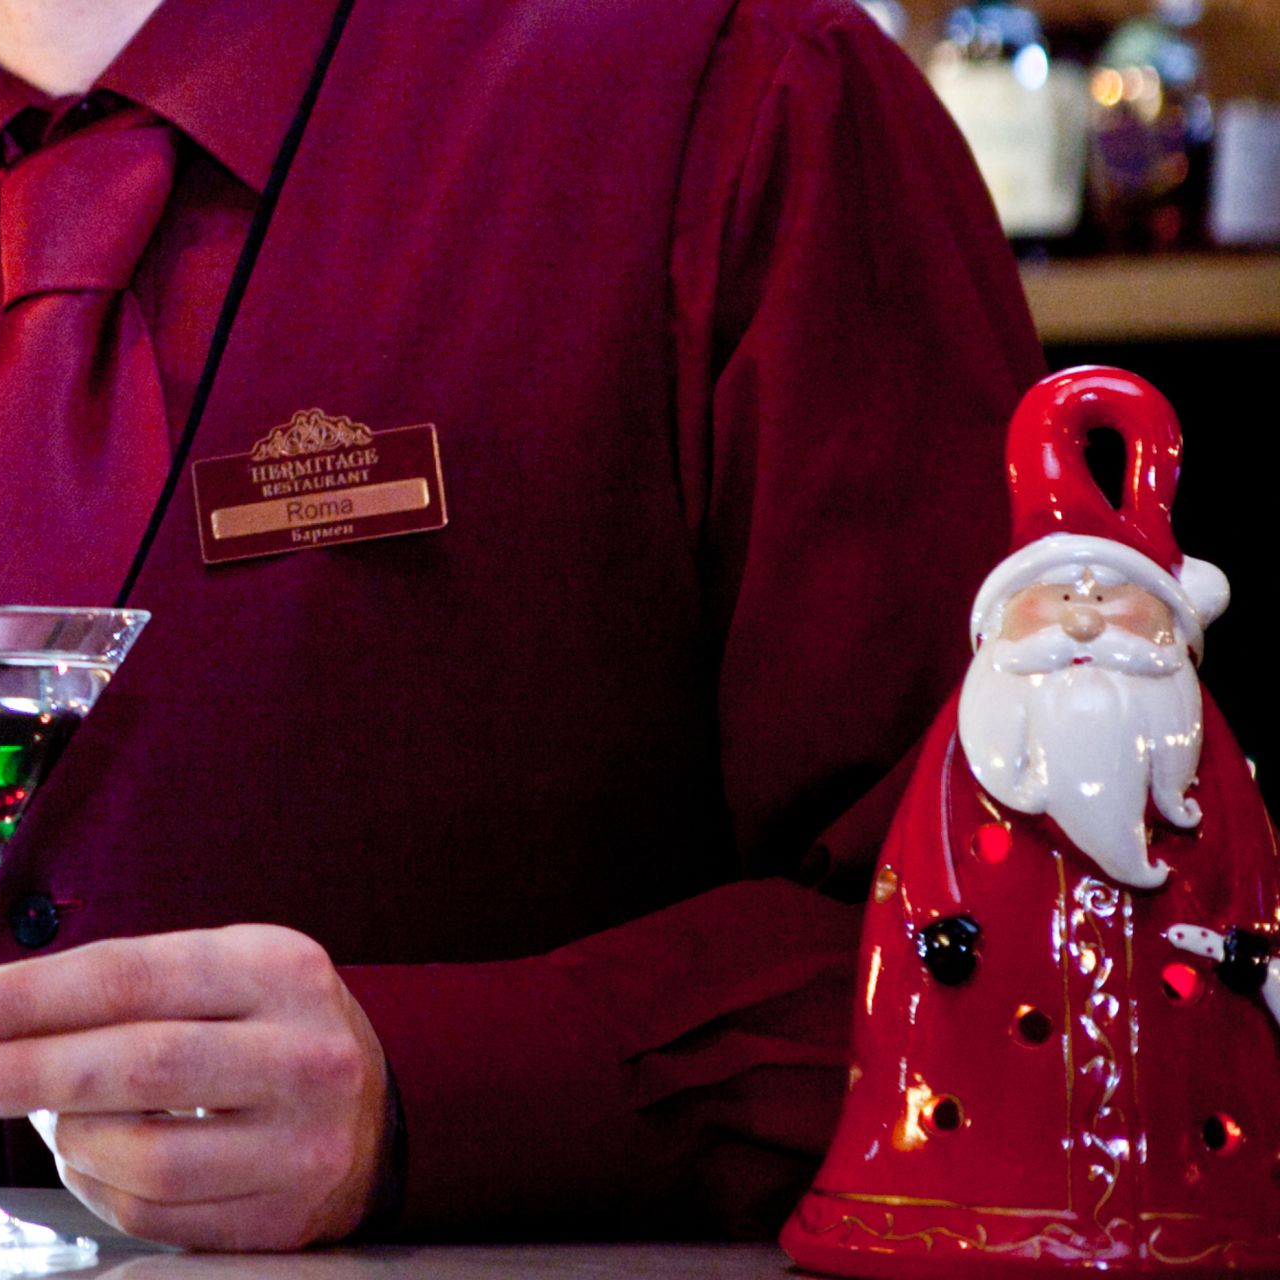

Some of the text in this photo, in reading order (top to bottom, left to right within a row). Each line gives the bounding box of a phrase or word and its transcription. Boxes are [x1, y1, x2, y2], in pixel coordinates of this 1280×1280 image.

[251, 448, 378, 483] HERMITAGE
[262, 469, 370, 497] RESTAURANT
[287, 497, 354, 521] Roma
[292, 524, 353, 543] Бармен
